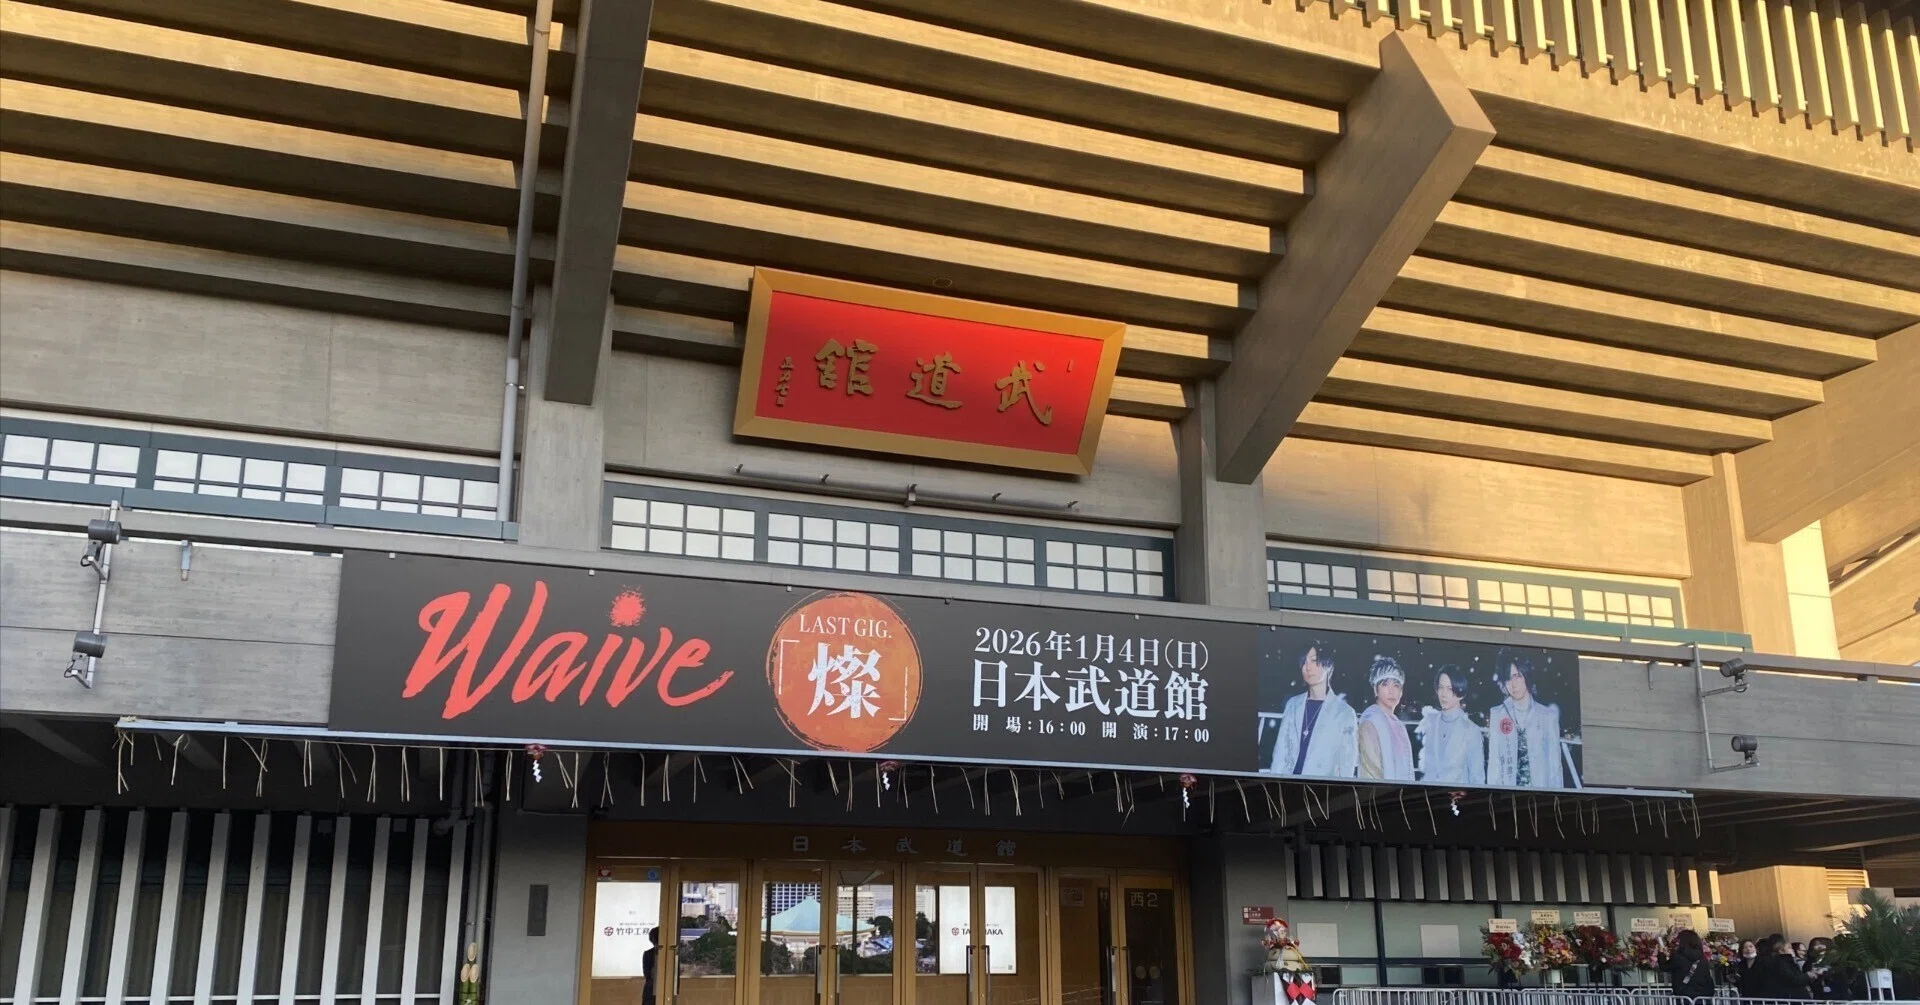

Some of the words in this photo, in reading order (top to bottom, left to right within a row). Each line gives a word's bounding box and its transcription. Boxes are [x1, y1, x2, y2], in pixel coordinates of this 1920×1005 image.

[815, 338, 1053, 426] 武道館
[799, 613, 850, 636] LAST
[854, 618, 892, 639] GIG.
[402, 580, 734, 720] Waive
[972, 658, 1209, 721] 日本武道館
[792, 835, 1017, 857] 日本武道館
[616, 927, 651, 936] 竹中工務
